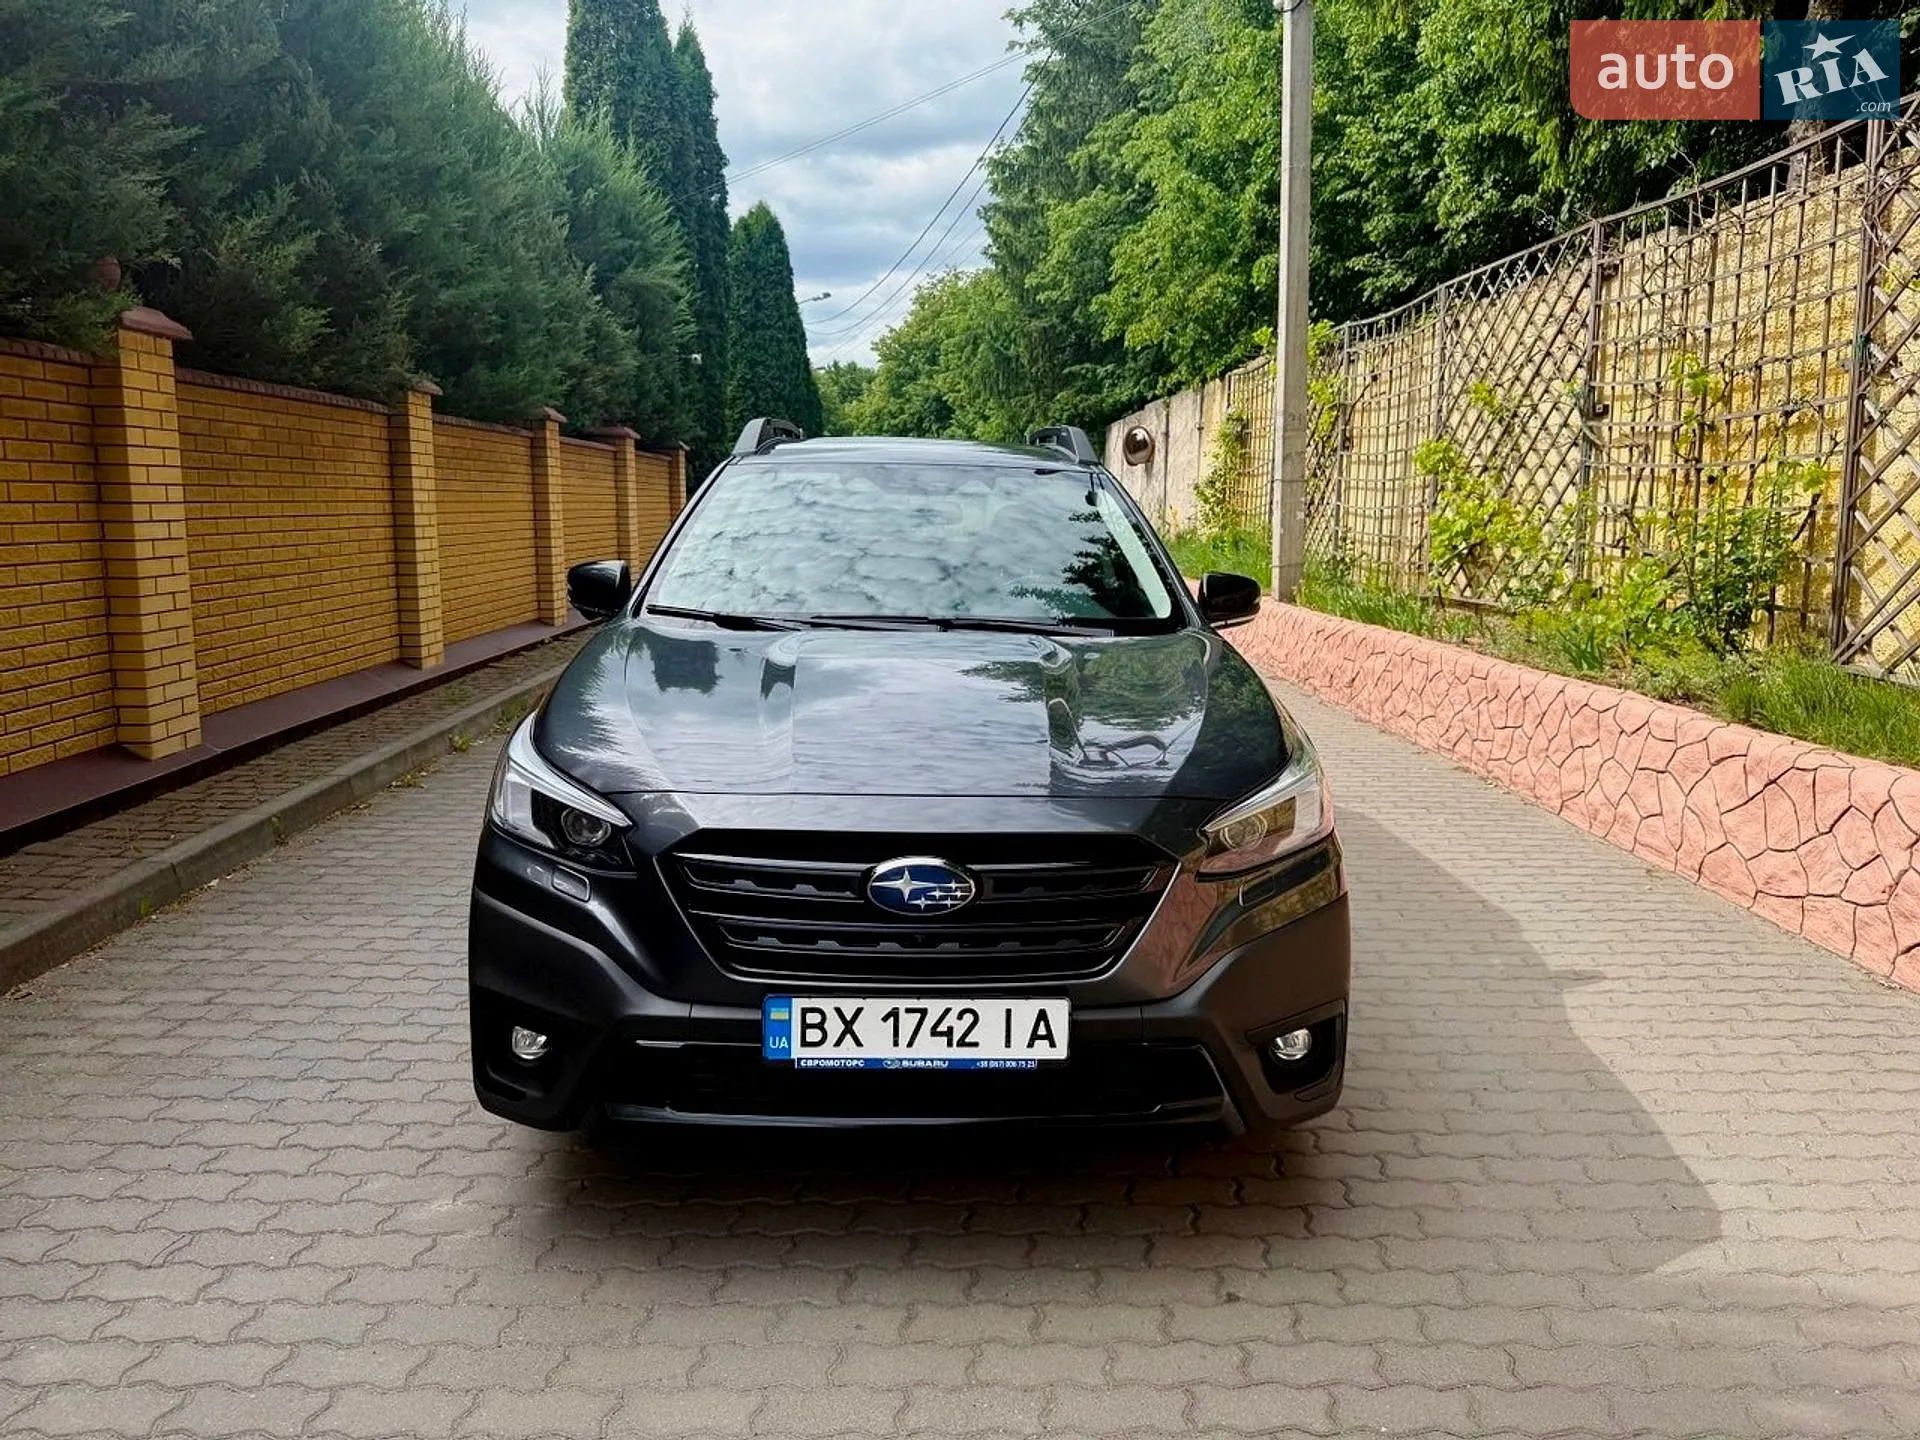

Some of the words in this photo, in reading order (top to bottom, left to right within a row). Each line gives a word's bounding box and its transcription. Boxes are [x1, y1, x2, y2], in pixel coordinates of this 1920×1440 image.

[800, 1007, 864, 1048] BX
[881, 1007, 980, 1048] 1742
[1004, 1008, 1057, 1048] IA
[770, 1037, 789, 1049] UA
[901, 1060, 948, 1068] SUBARU
